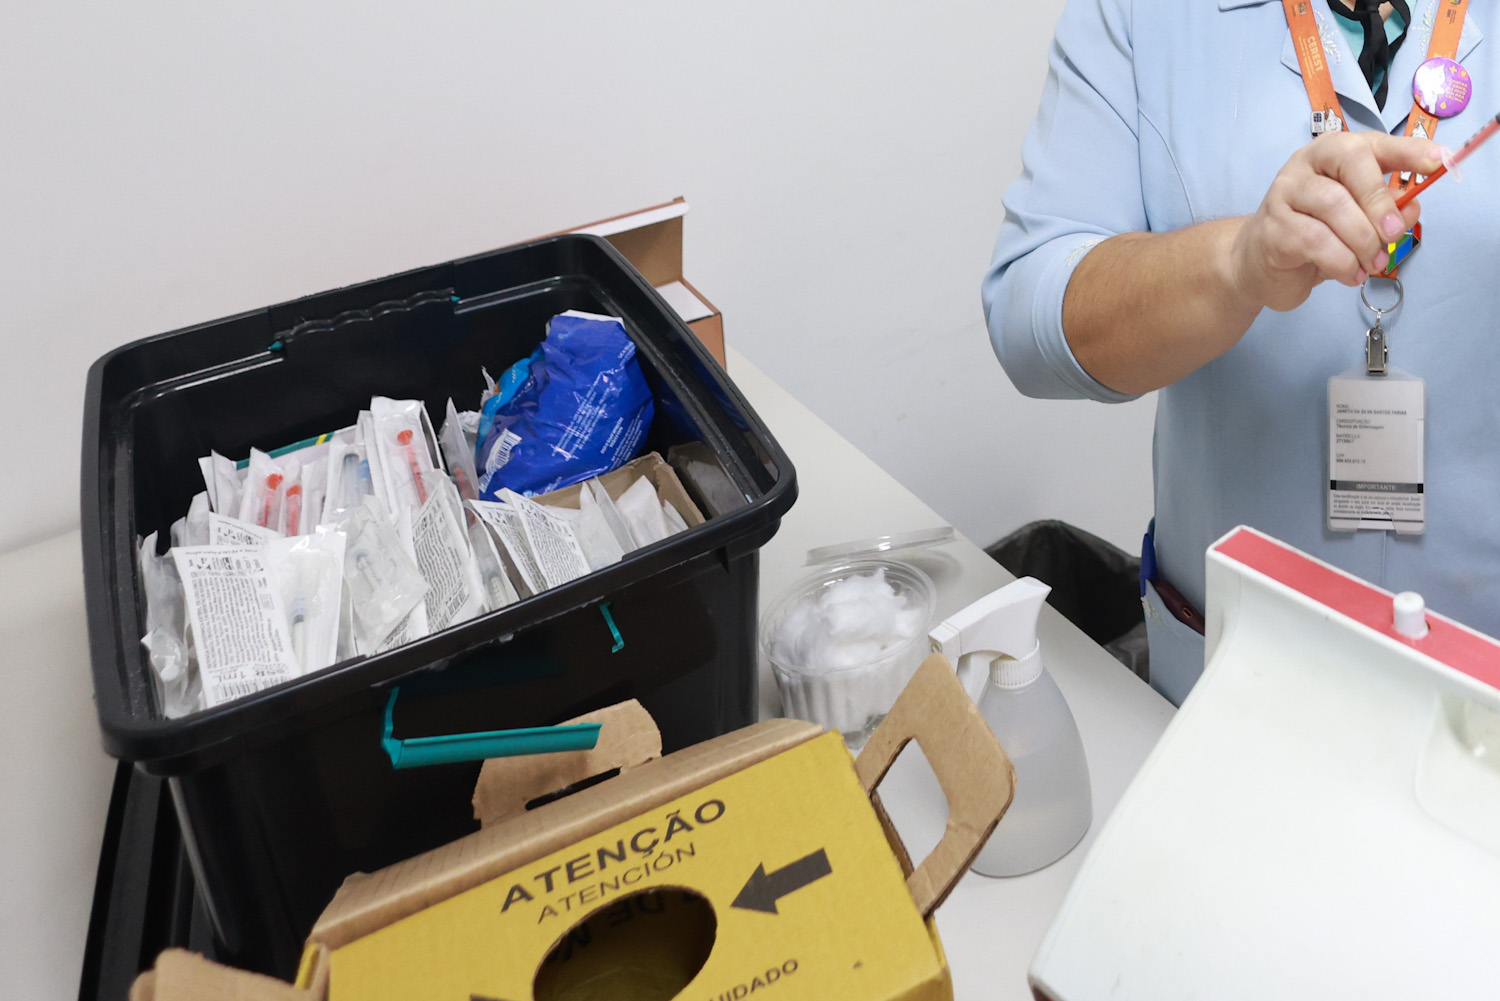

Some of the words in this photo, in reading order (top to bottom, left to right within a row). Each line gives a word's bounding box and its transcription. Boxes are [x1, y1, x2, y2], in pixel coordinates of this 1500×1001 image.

[1306, 36, 1323, 72] CEREST
[1355, 483, 1396, 491] IMPORTANTE
[501, 798, 726, 914] ATENÇÃO
[537, 842, 696, 925] ATENCIÓN
